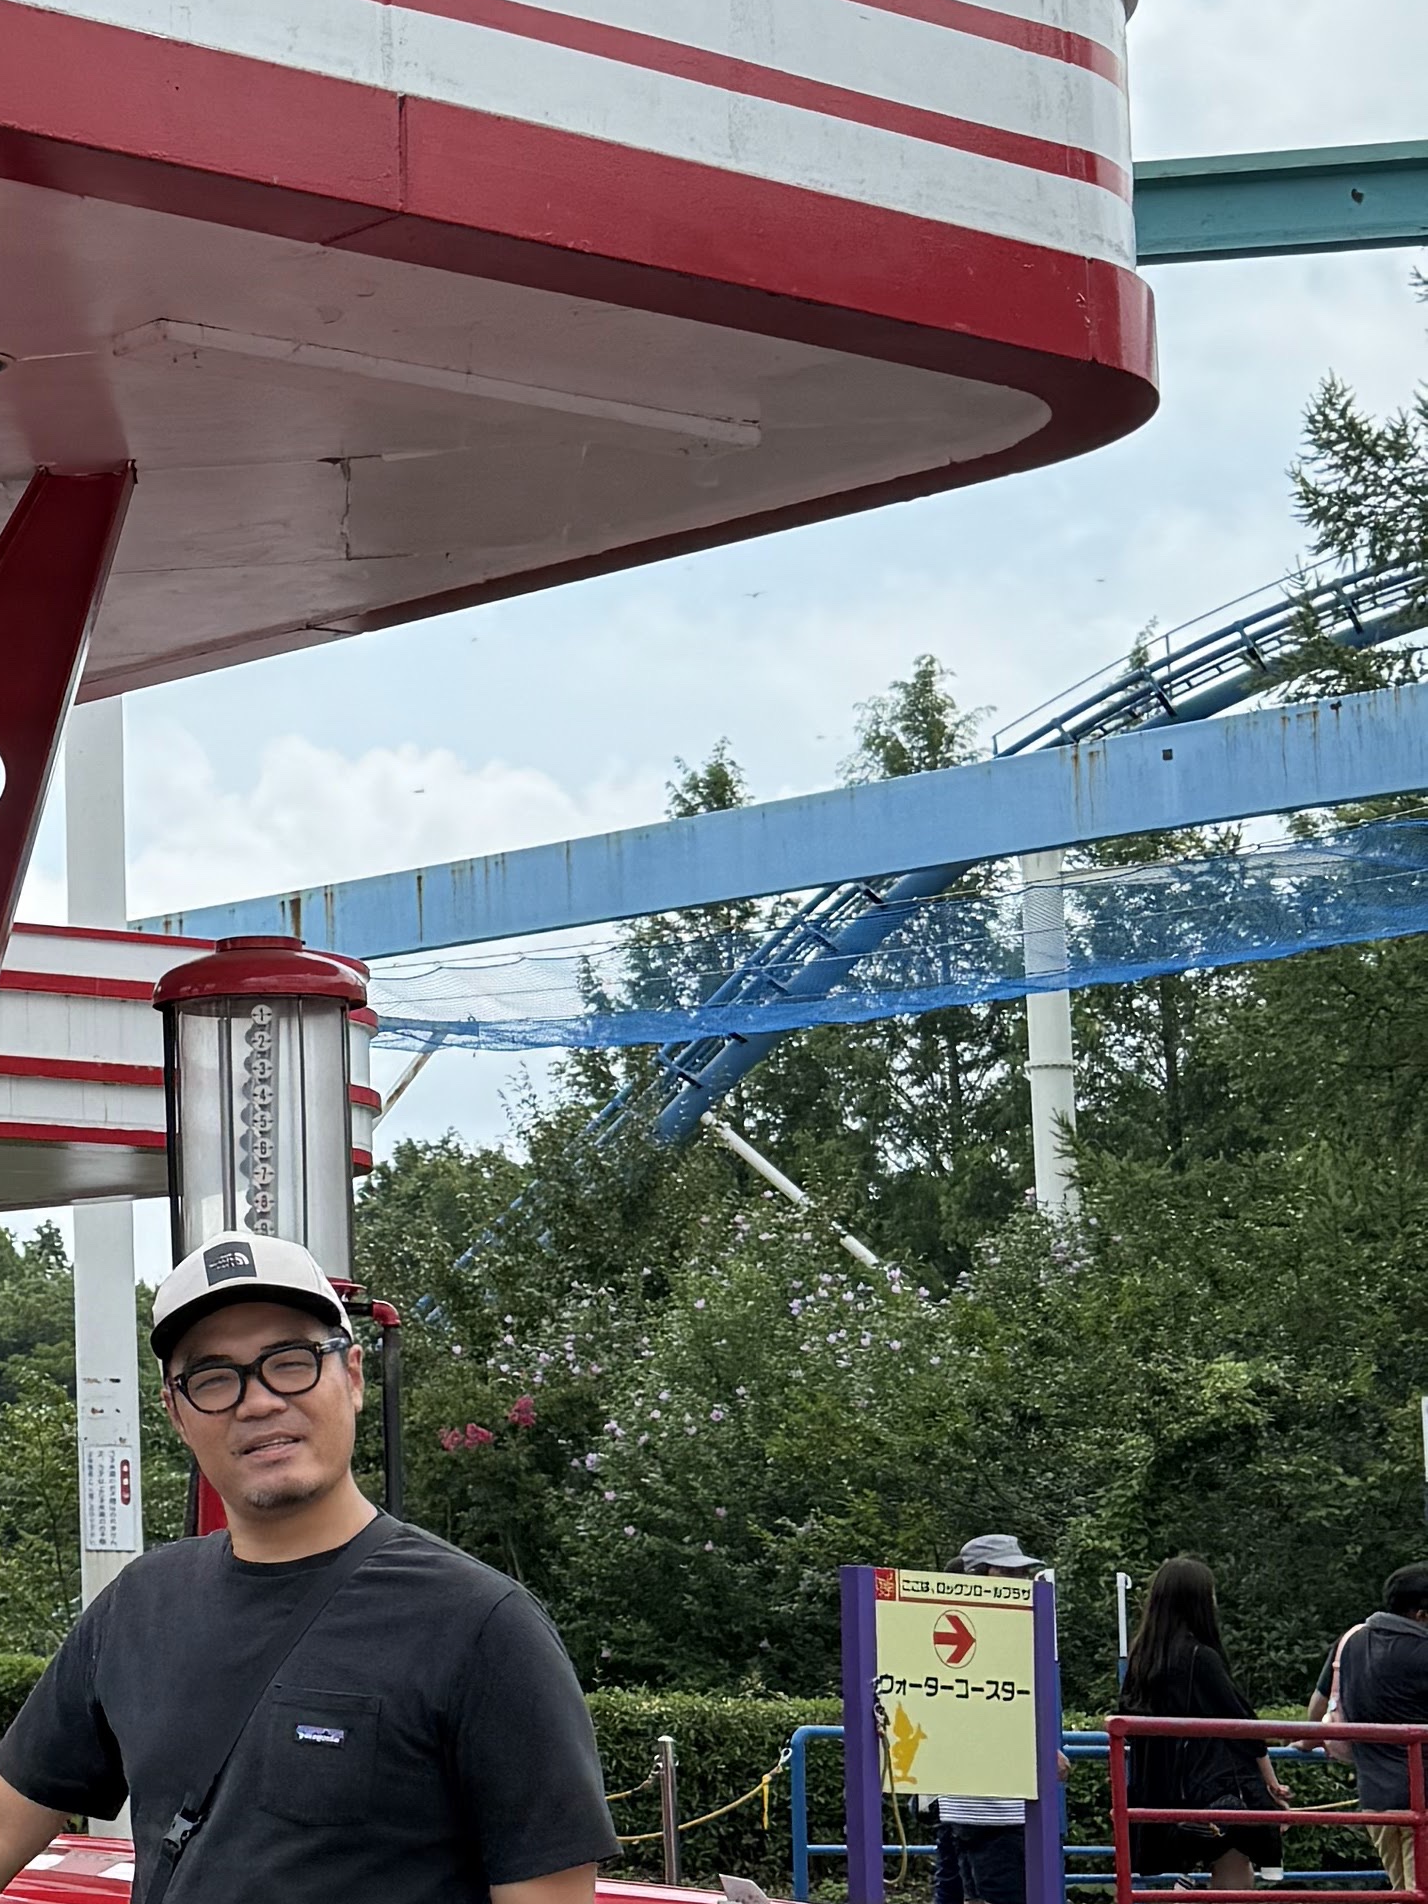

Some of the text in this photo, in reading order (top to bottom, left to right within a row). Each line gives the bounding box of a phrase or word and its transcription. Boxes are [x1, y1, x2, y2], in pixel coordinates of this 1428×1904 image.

[879, 1674, 1030, 1702] ウォーターコースター
